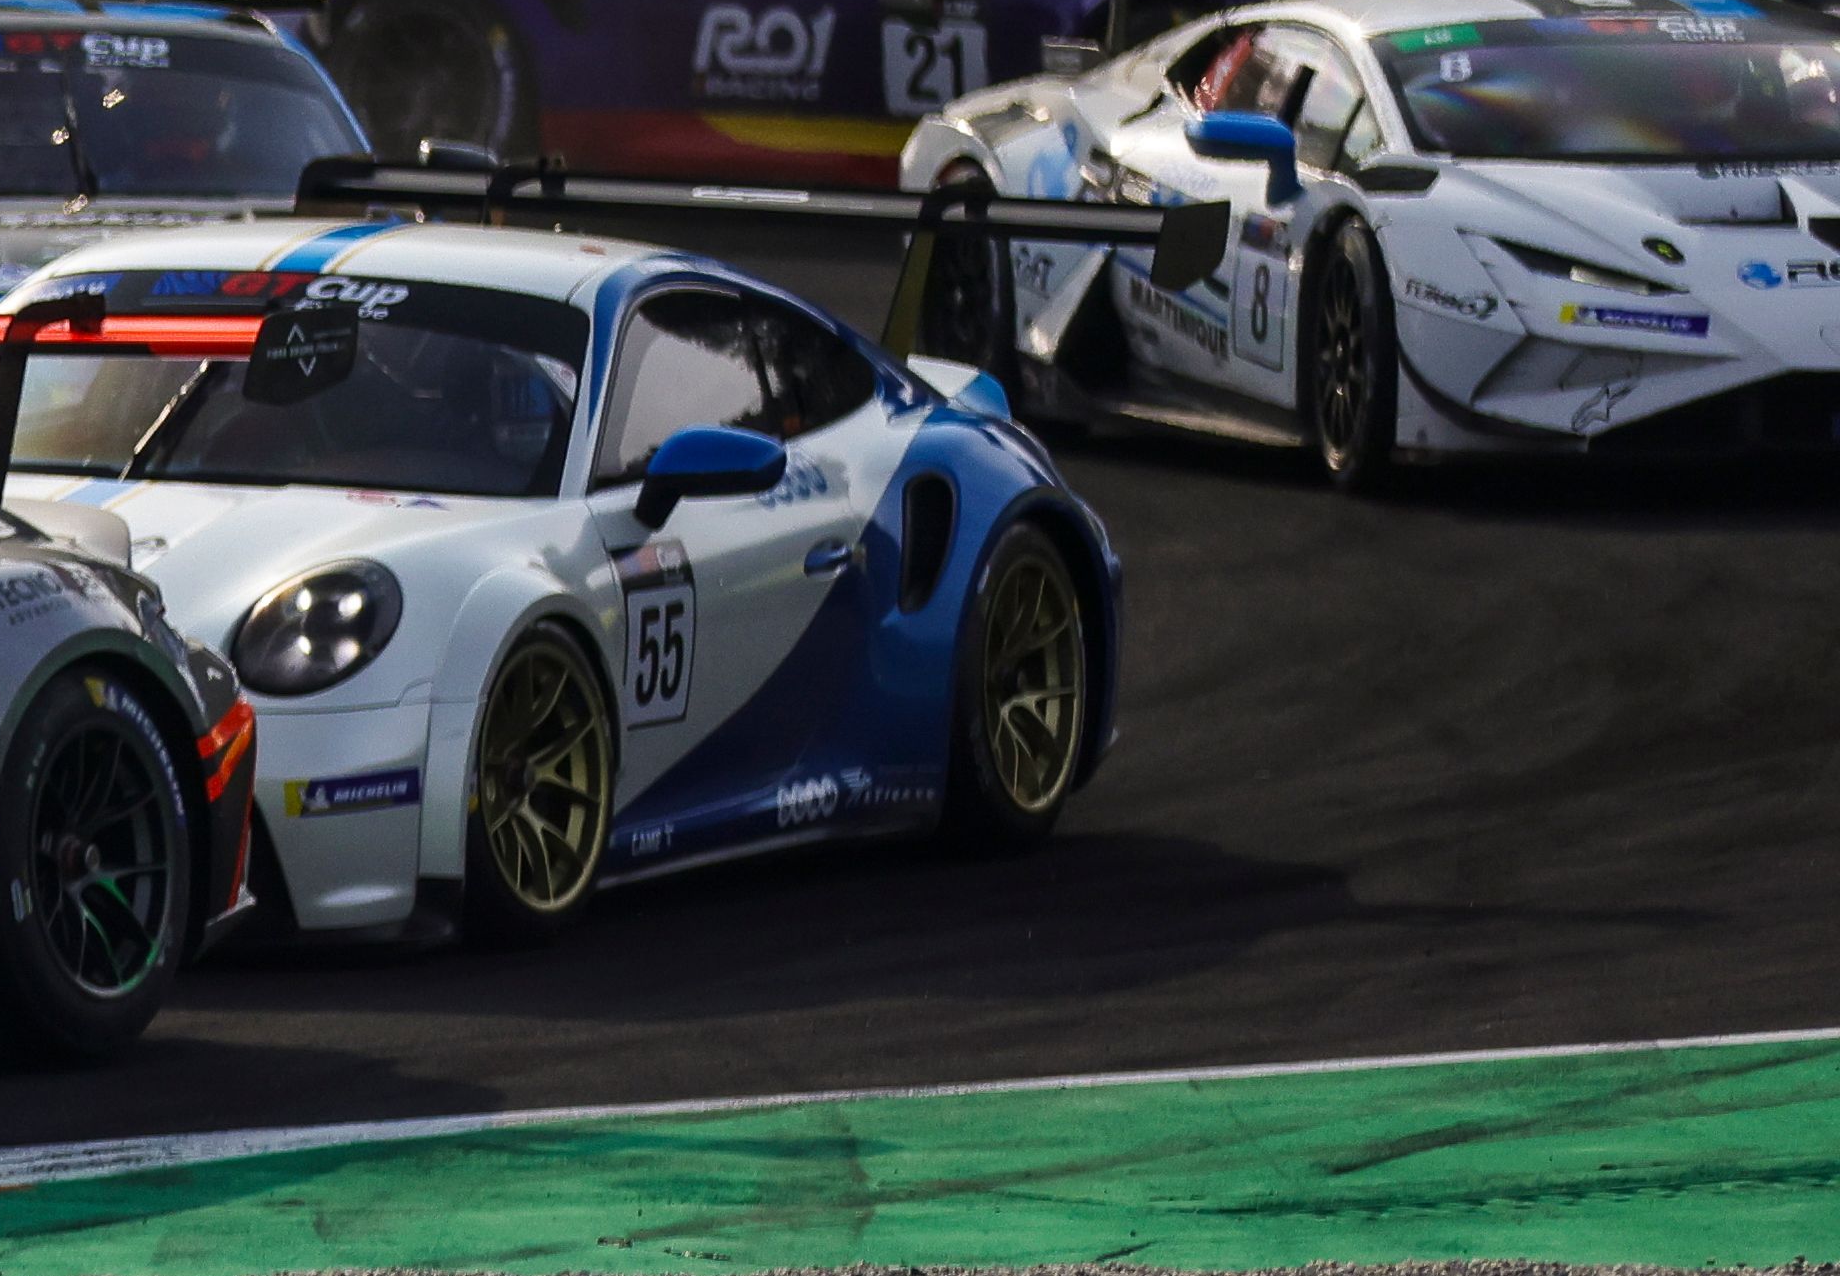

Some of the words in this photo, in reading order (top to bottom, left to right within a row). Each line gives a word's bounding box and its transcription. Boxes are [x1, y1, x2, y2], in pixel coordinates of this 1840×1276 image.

[906, 35, 966, 101] 21
[223, 273, 314, 299] GT
[305, 275, 410, 307] Cup
[1128, 274, 1230, 362] MARTINIQUE
[1247, 261, 1271, 343] 8
[635, 600, 685, 707] 55
[333, 777, 409, 802] MICHELIN
